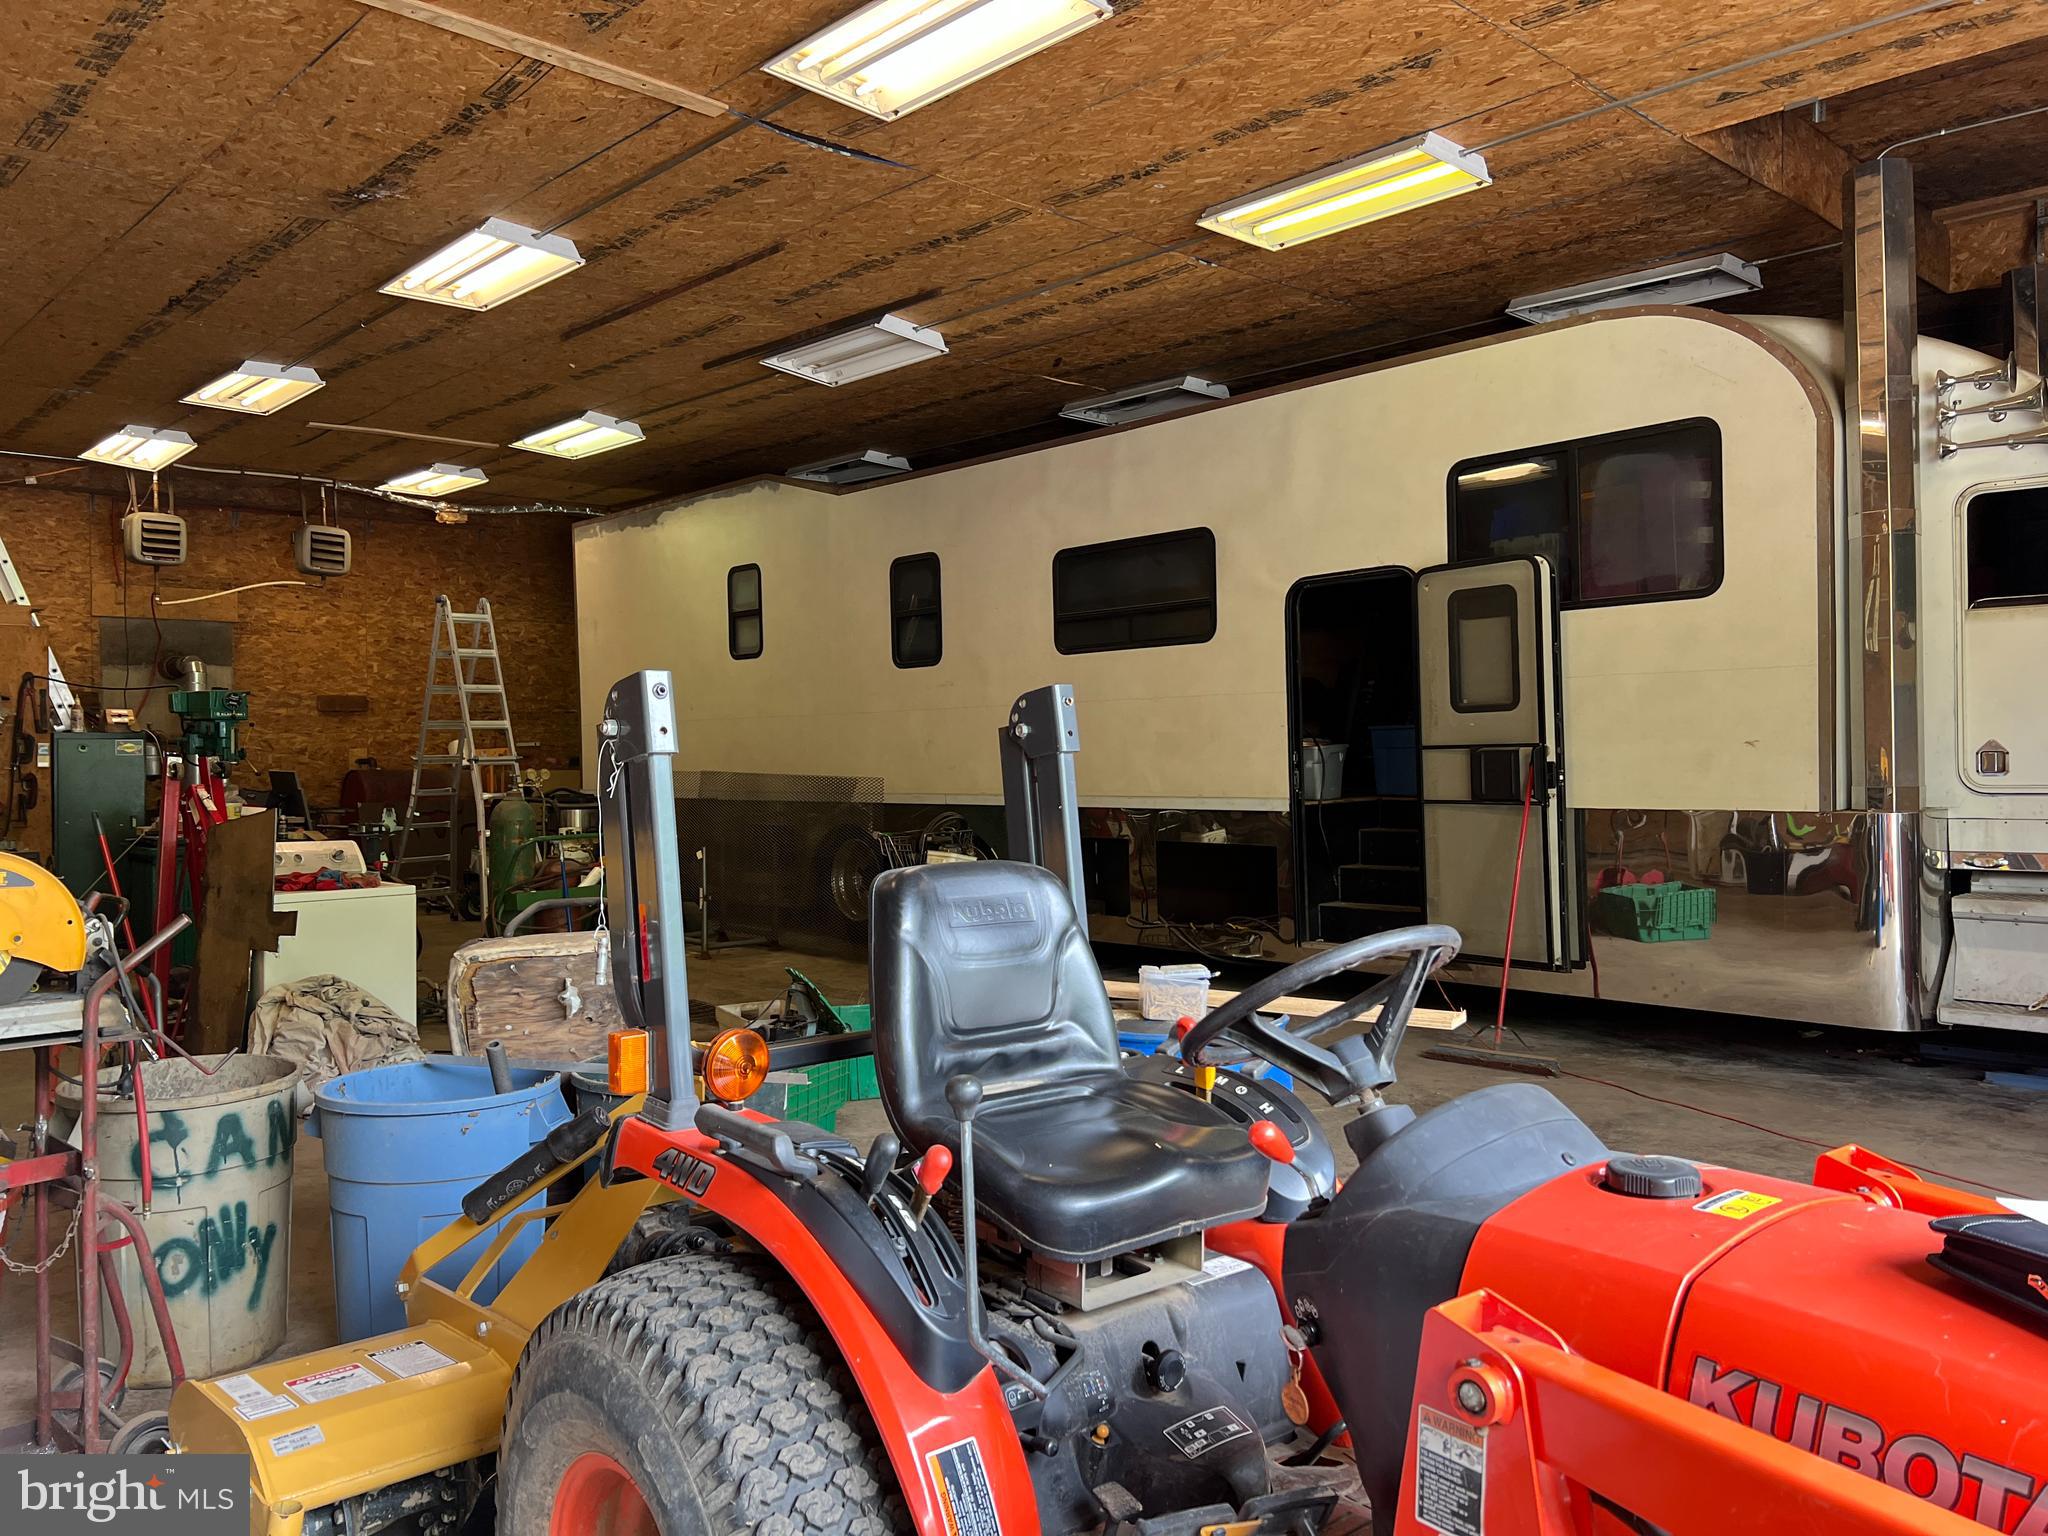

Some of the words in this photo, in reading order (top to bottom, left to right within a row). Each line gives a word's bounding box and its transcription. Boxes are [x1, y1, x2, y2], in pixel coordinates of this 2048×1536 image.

[951, 897, 1026, 923] Kubota
[1258, 1102, 1275, 1114] H
[652, 1147, 716, 1197] 4WD
